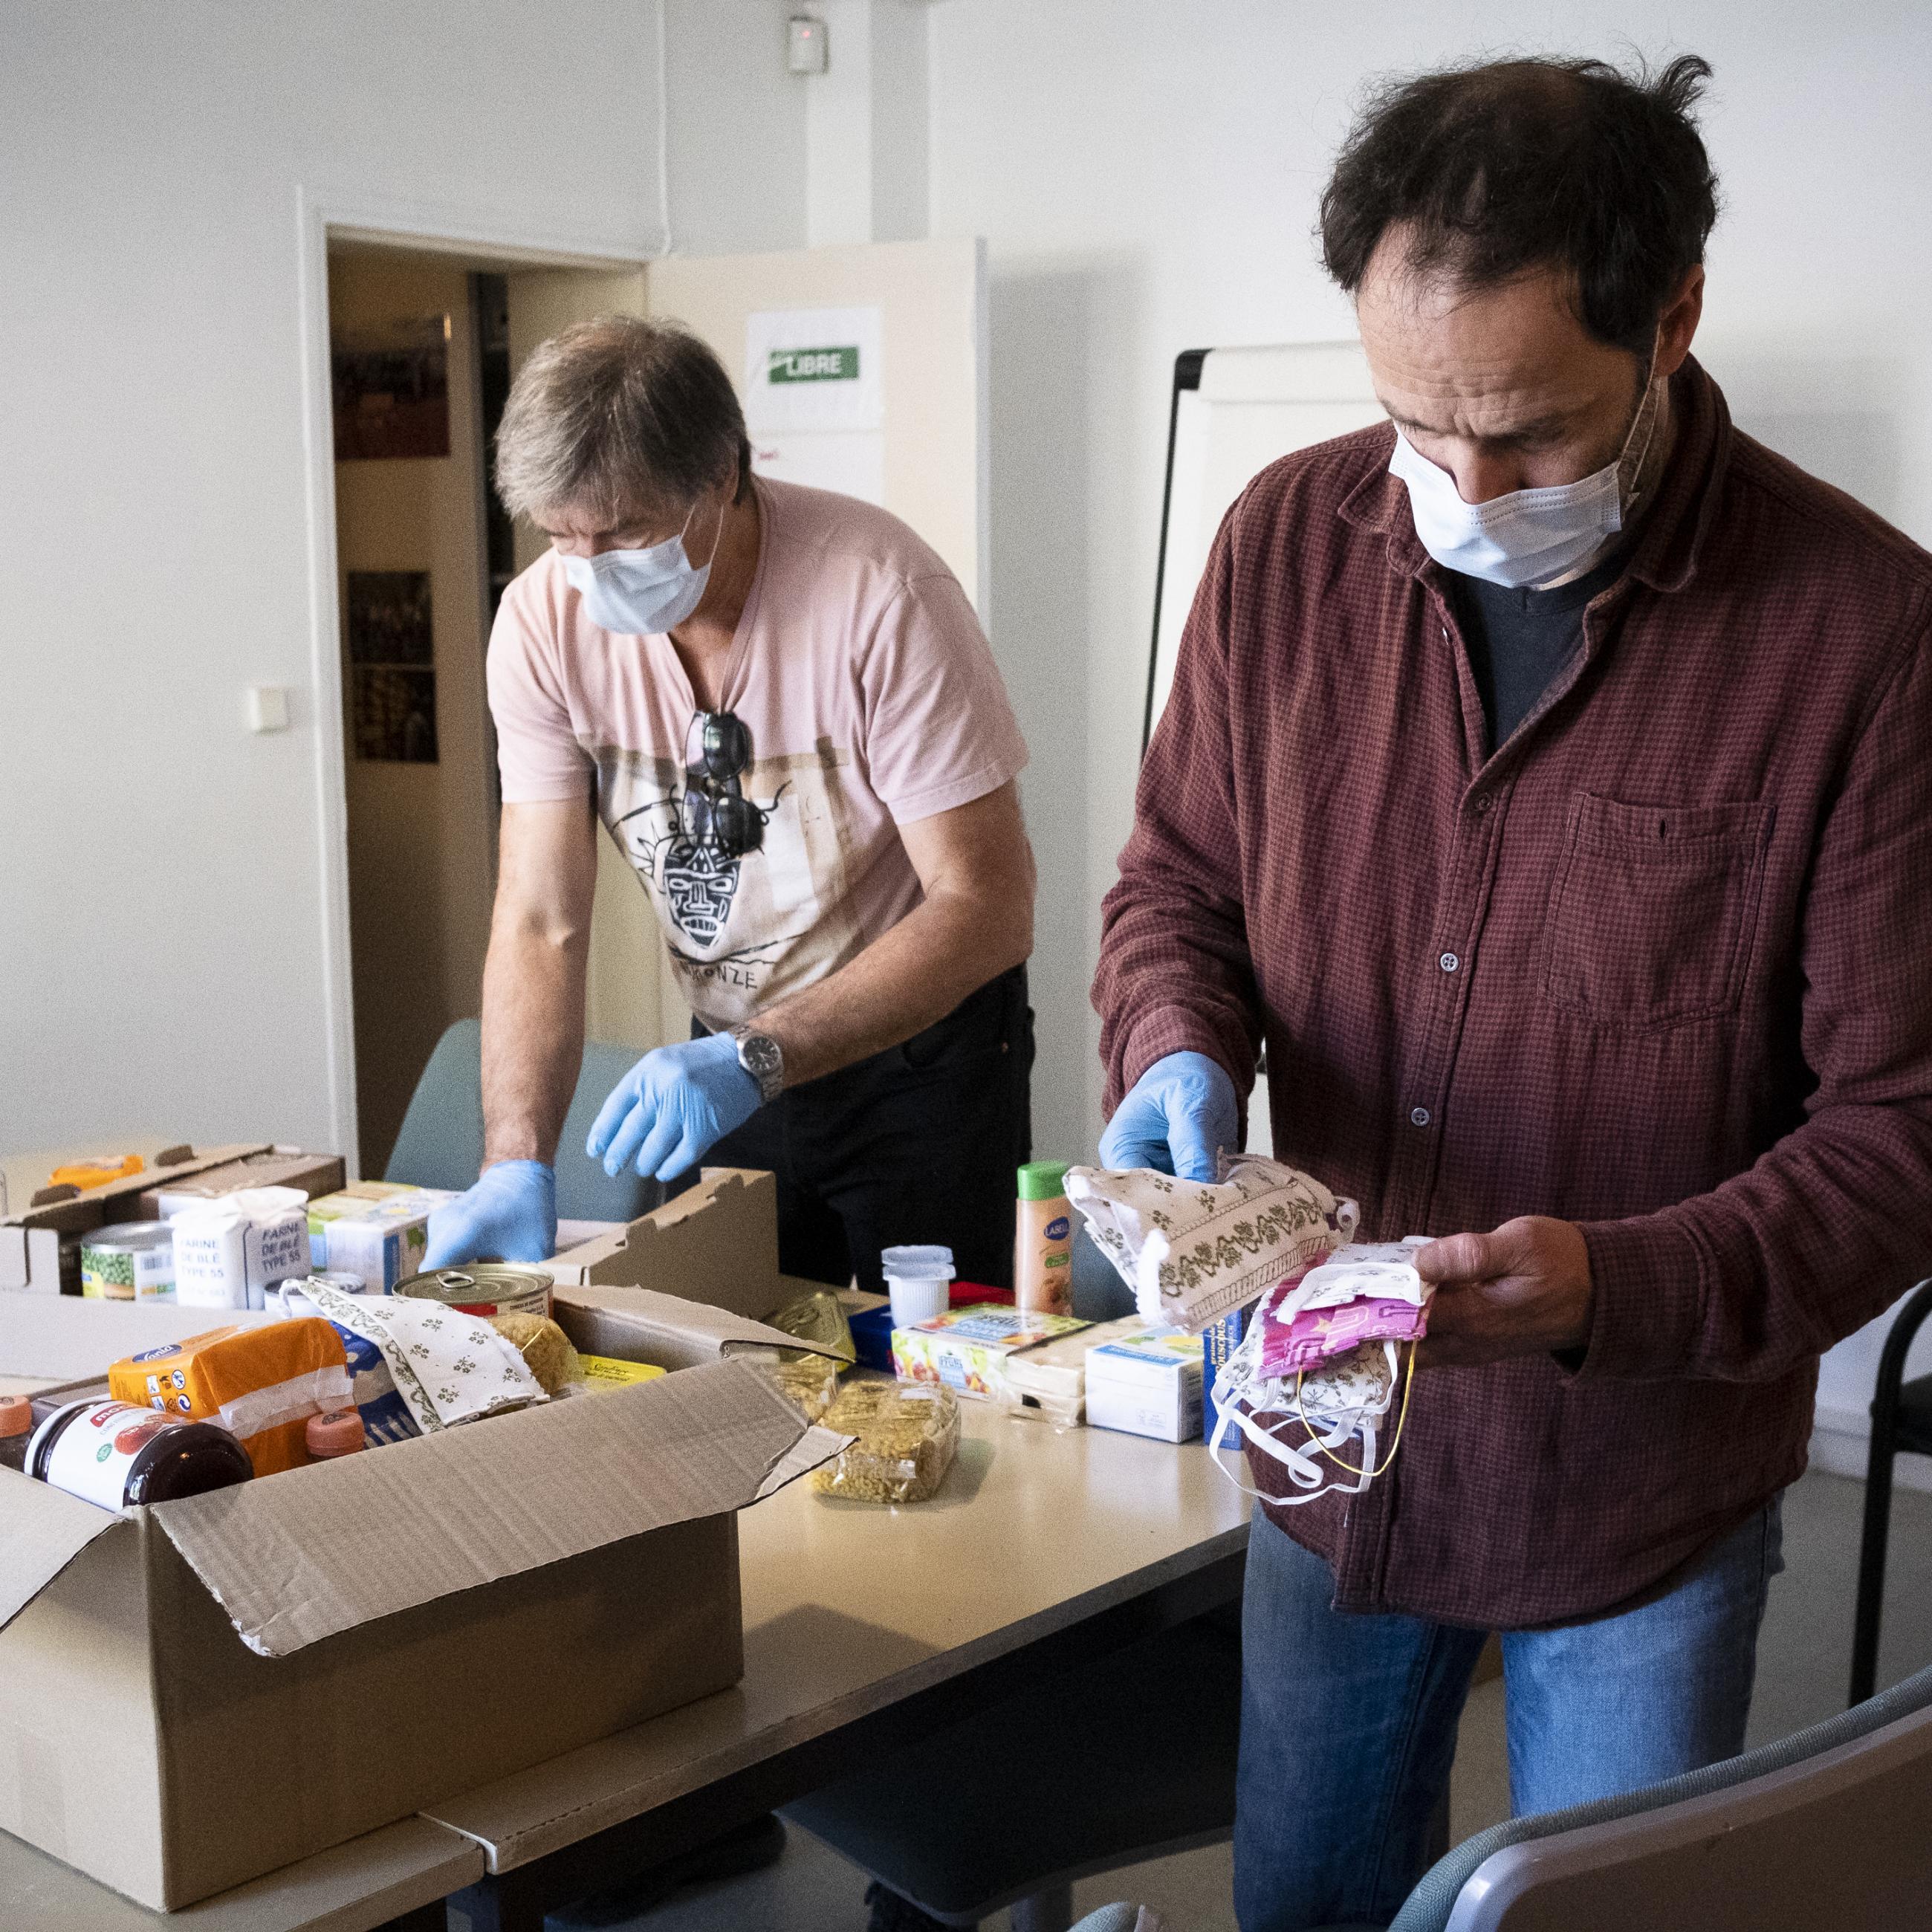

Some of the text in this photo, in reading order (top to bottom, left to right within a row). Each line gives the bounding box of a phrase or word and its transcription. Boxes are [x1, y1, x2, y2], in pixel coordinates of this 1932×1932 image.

[785, 353, 842, 377] LIBRE
[262, 1222, 299, 1240] FARINE
[262, 1242, 279, 1257] DE
[181, 1265, 204, 1277] TYPE
[262, 1253, 287, 1271] TYPE
